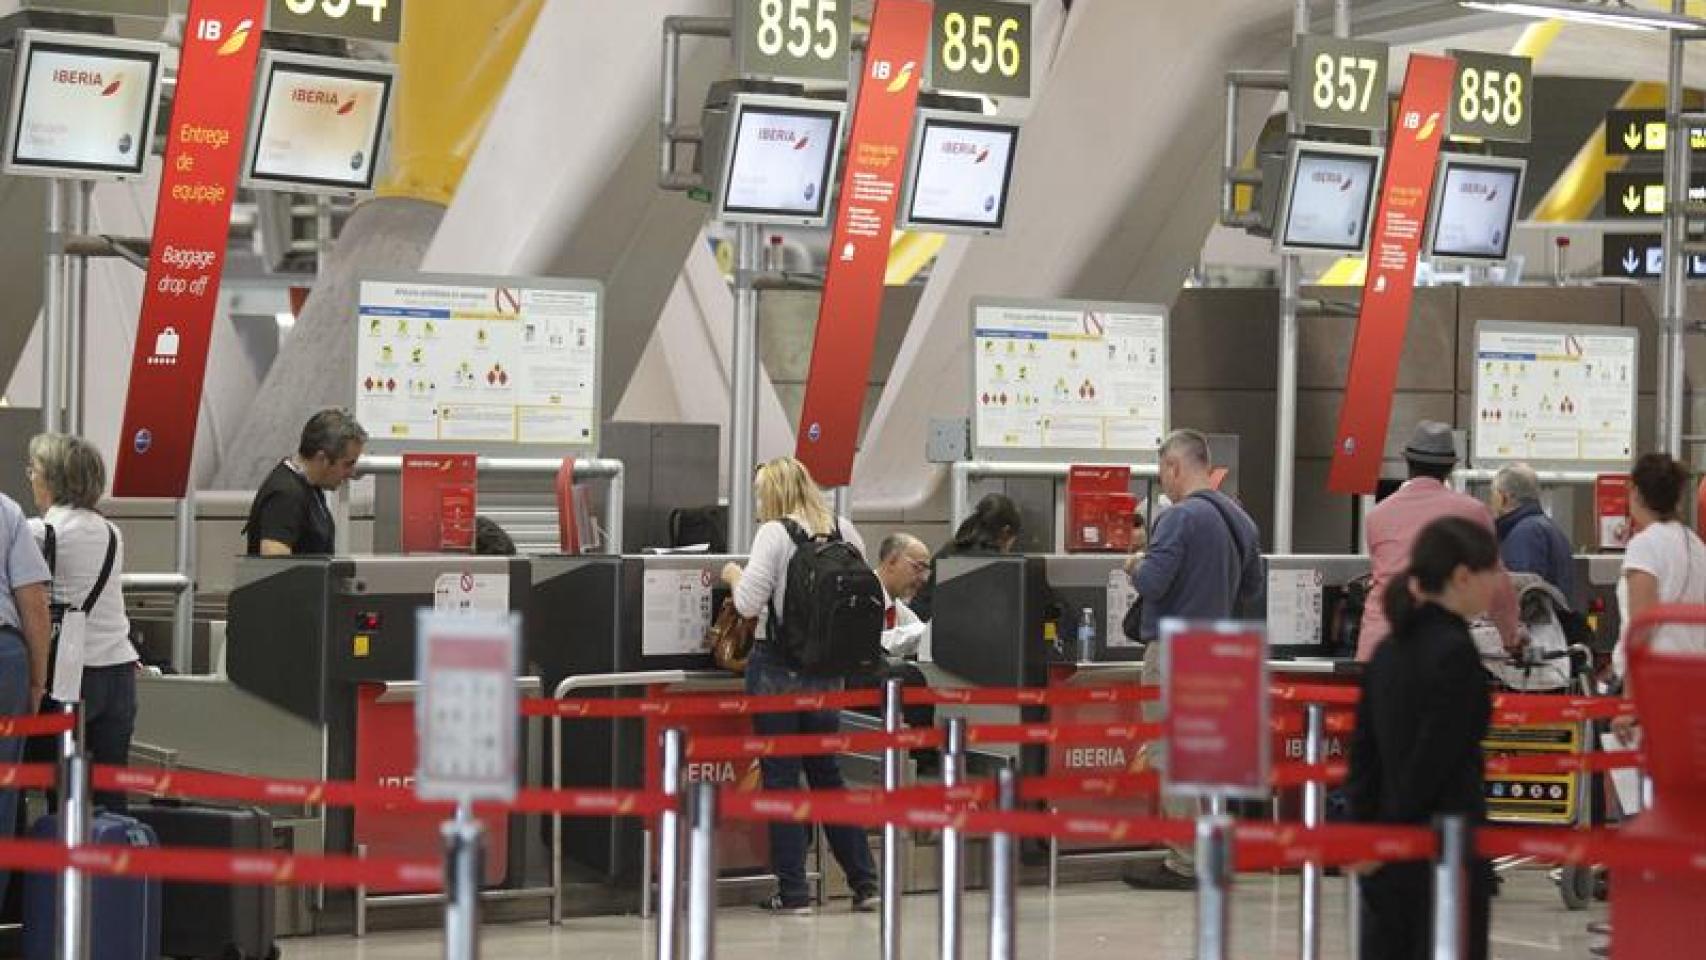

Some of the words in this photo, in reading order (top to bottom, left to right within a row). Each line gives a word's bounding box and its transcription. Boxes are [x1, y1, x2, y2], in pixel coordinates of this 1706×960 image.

[197, 20, 222, 40] IB
[757, 0, 838, 59] 855
[942, 12, 1021, 77] 856
[52, 69, 103, 87] IBERIA
[871, 61, 890, 80] IB
[1313, 52, 1378, 113] 857
[290, 88, 338, 105] IBERIA
[1459, 67, 1523, 127] 858
[180, 124, 229, 147] Entrega
[176, 154, 194, 172] de
[172, 184, 227, 203] equipaje
[162, 245, 217, 270] Baggage
[157, 274, 187, 296] drop
[189, 274, 210, 296] off
[1065, 747, 1126, 768] IBERIA
[1286, 737, 1343, 759] IBIA
[682, 761, 737, 783] ERIA
